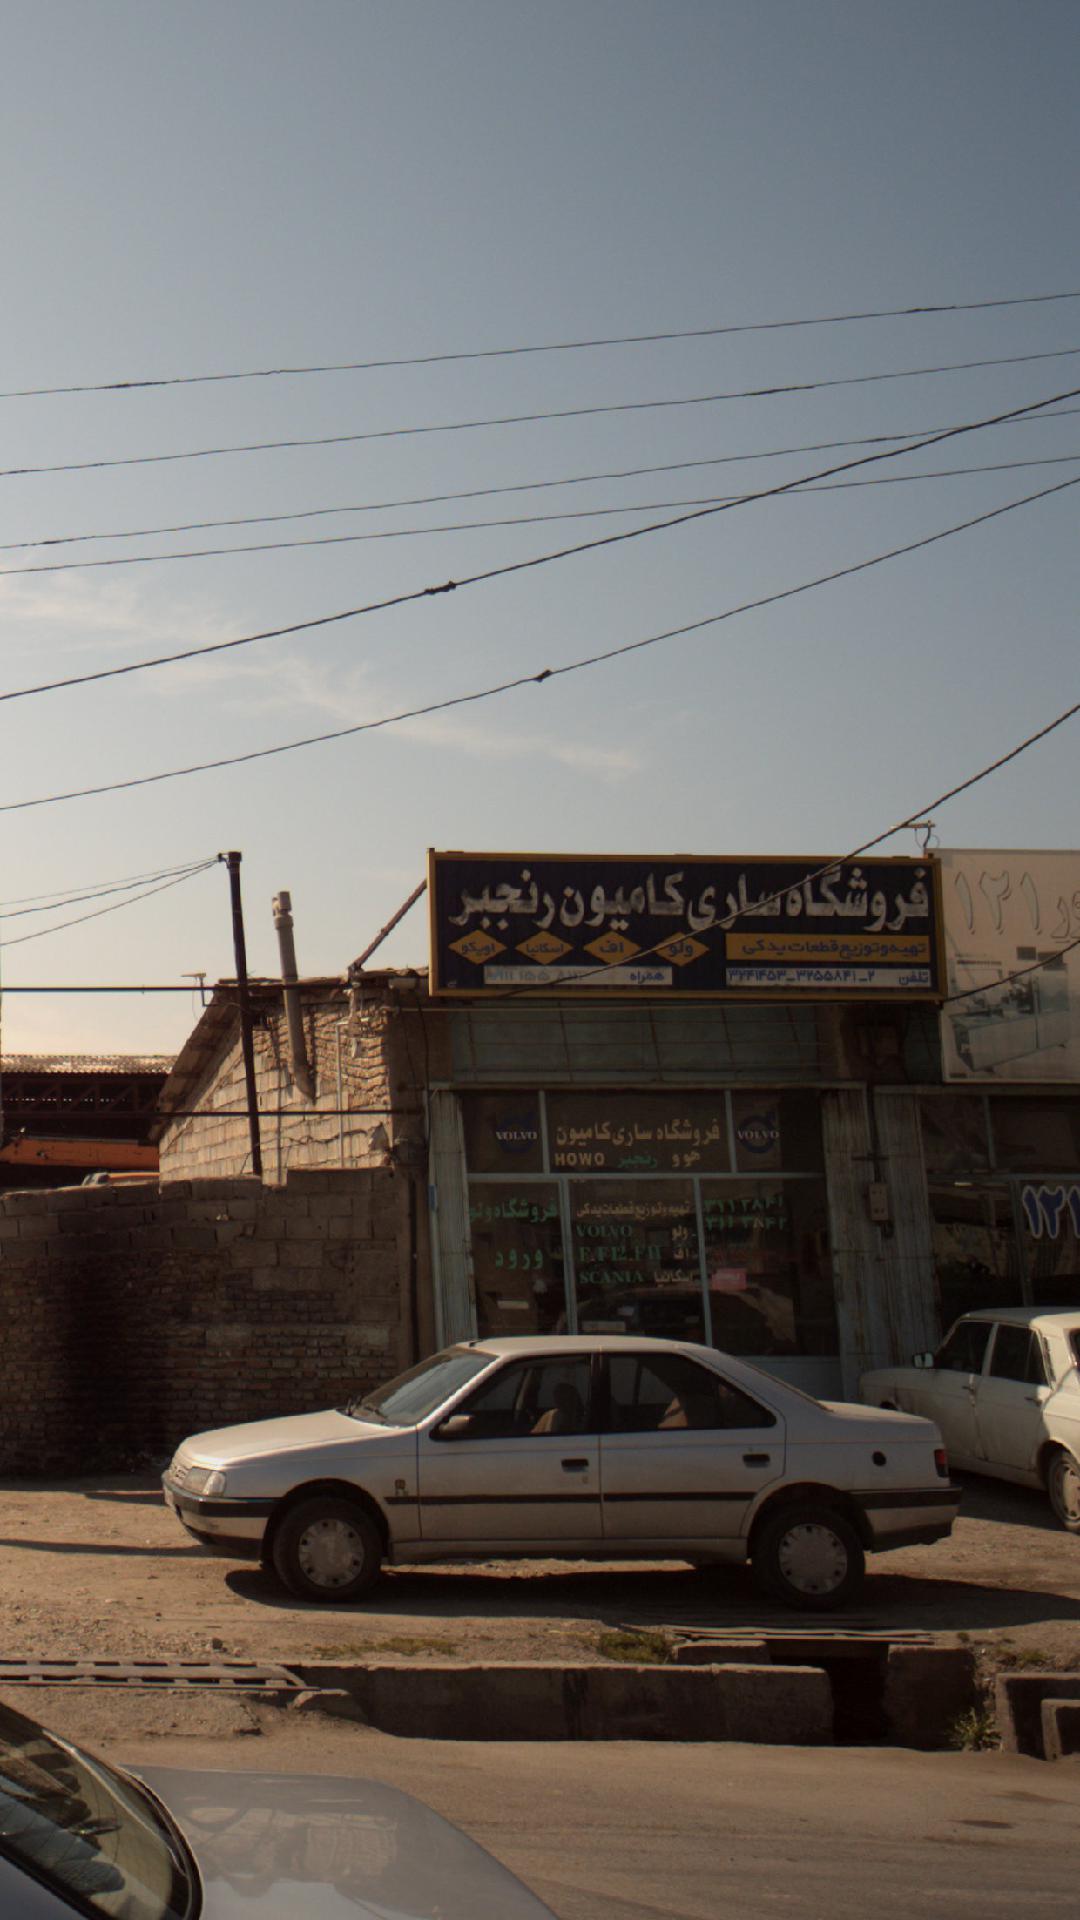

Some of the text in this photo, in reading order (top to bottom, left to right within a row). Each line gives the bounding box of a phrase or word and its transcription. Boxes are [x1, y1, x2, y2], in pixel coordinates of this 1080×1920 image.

[448, 865, 930, 932] فروشگاه ساری کامیون رنجبر
[898, 973, 929, 986] تلفن
[495, 1129, 538, 1142] VOLVO
[556, 1117, 722, 1148] فروشگاه ساری کامیون
[737, 1128, 781, 1141] VOLVO
[554, 1151, 606, 1166] HOWO
[576, 1224, 634, 1239] VOLVO
[578, 1270, 645, 1285] SCANIA
